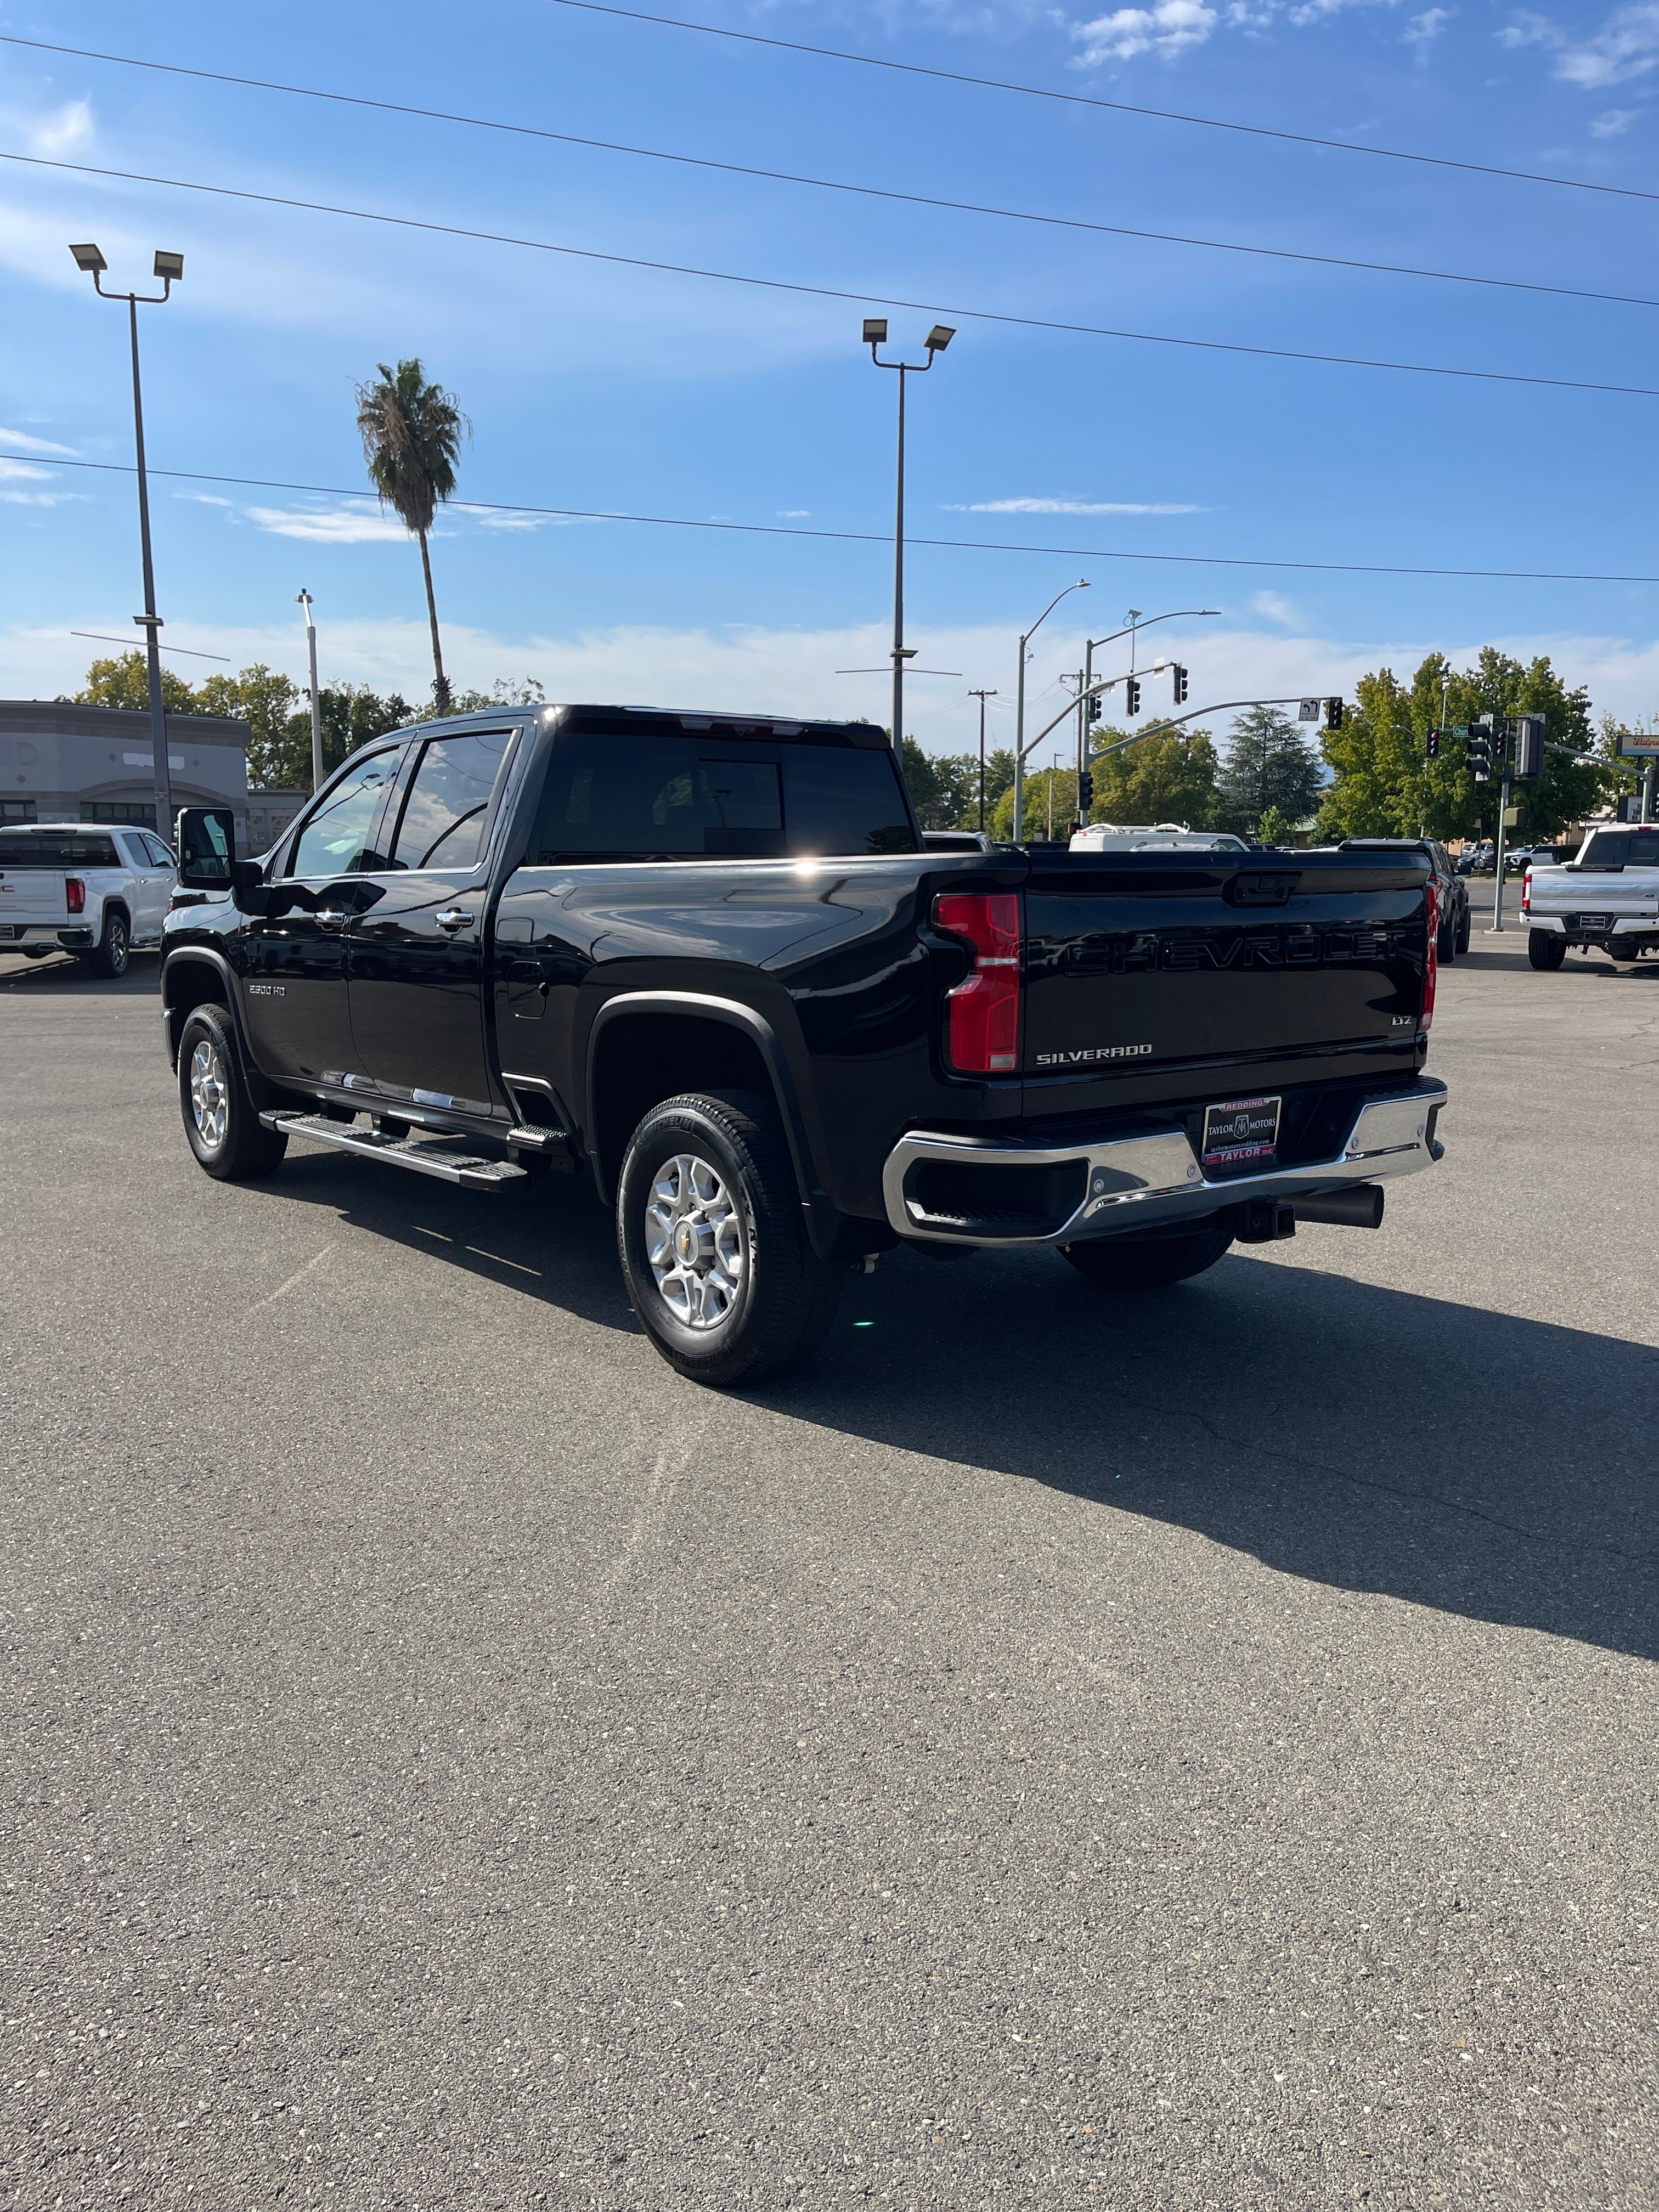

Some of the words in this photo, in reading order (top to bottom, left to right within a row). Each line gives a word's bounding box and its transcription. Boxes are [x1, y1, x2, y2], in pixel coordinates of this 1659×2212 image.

[1064, 930, 1406, 977] CHEVROLET
[273, 986, 285, 996] HD
[1392, 1015, 1413, 1025] LTZ
[1036, 1044, 1152, 1065] SILVERADO
[1226, 1099, 1263, 1111] REDDING
[644, 1116, 692, 1139] MICHELIN
[1208, 1124, 1234, 1136] TAYLOR
[1249, 1118, 1276, 1130] MOTORS
[1210, 1139, 1270, 1153] taylormotorsredding.com
[1220, 1148, 1261, 1161] TAYLOR
